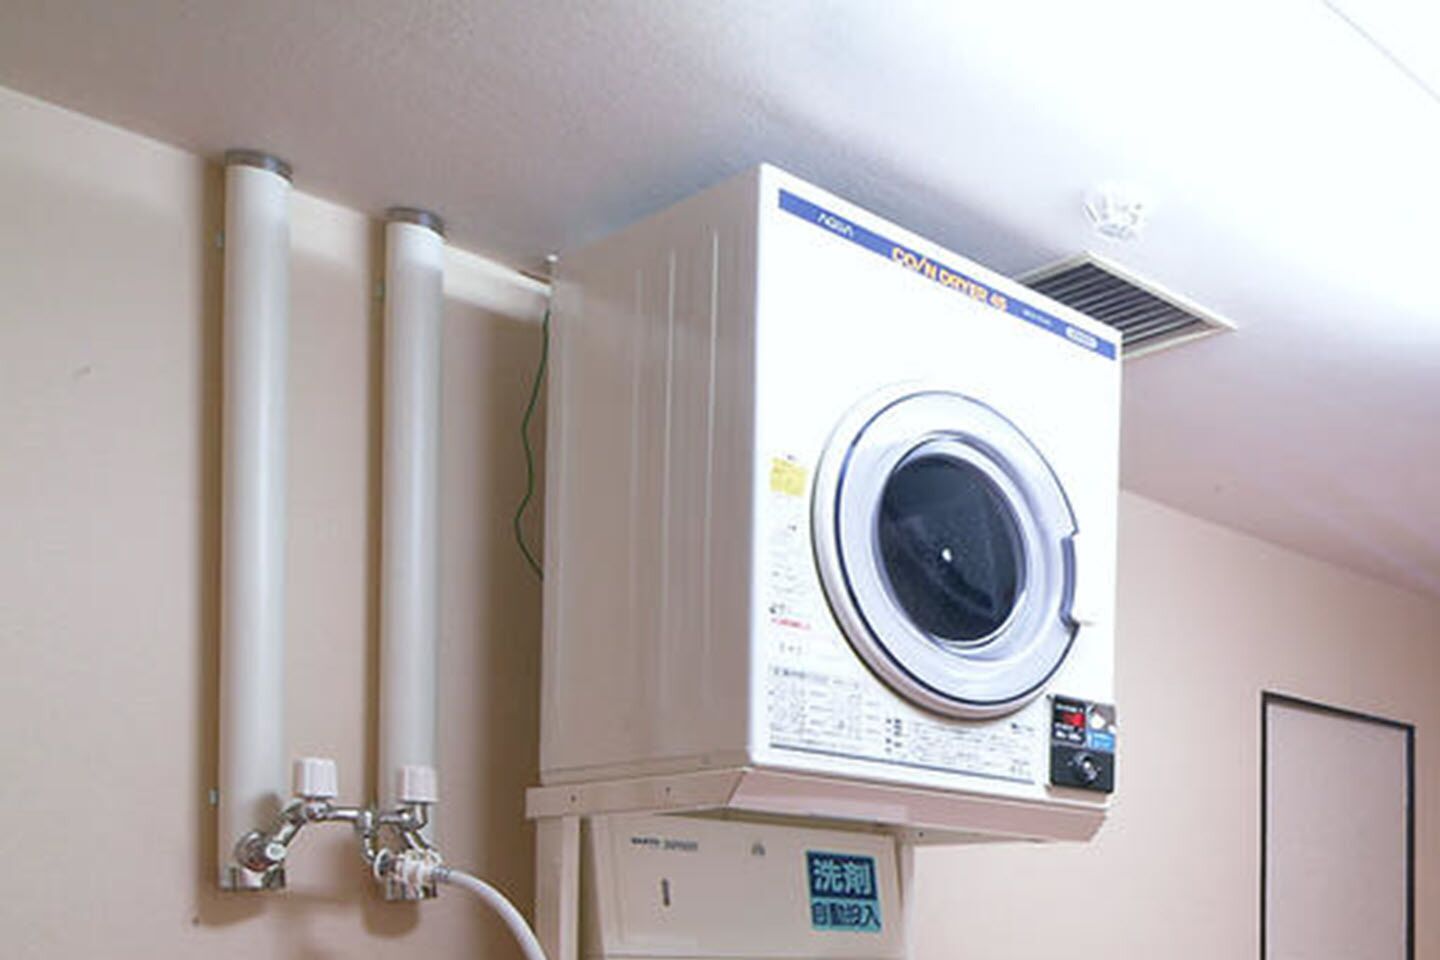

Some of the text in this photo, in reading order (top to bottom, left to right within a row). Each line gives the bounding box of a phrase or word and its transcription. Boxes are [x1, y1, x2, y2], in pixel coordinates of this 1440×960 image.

[814, 858, 873, 895] 洗剤
[812, 902, 882, 928] 自動投入
